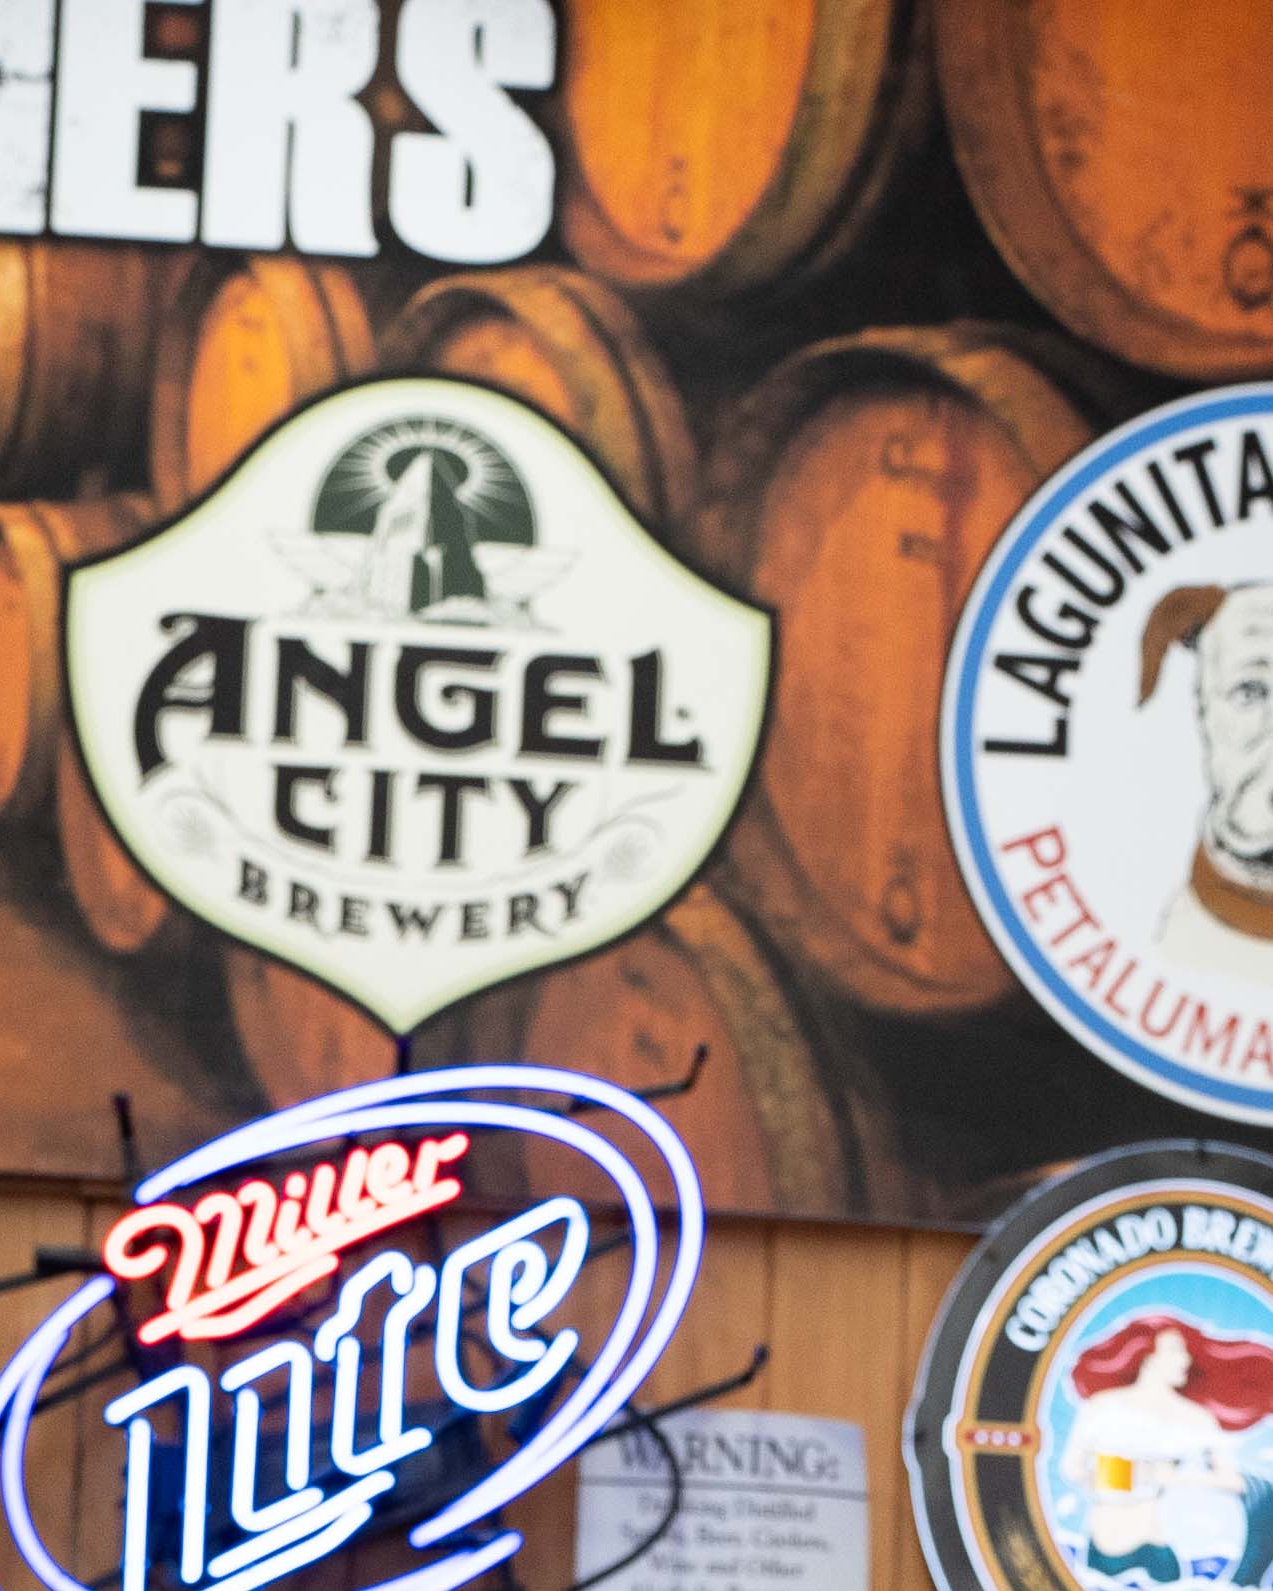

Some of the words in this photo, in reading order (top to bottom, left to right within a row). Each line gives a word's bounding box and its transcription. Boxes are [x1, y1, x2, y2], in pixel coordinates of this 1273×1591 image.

[133, 611, 713, 792] ANGEL
[273, 763, 579, 867] CITY
[238, 857, 592, 942] BREWERY
[102, 1131, 471, 1335] Miller
[1004, 1206, 1177, 1352] CORONADO
